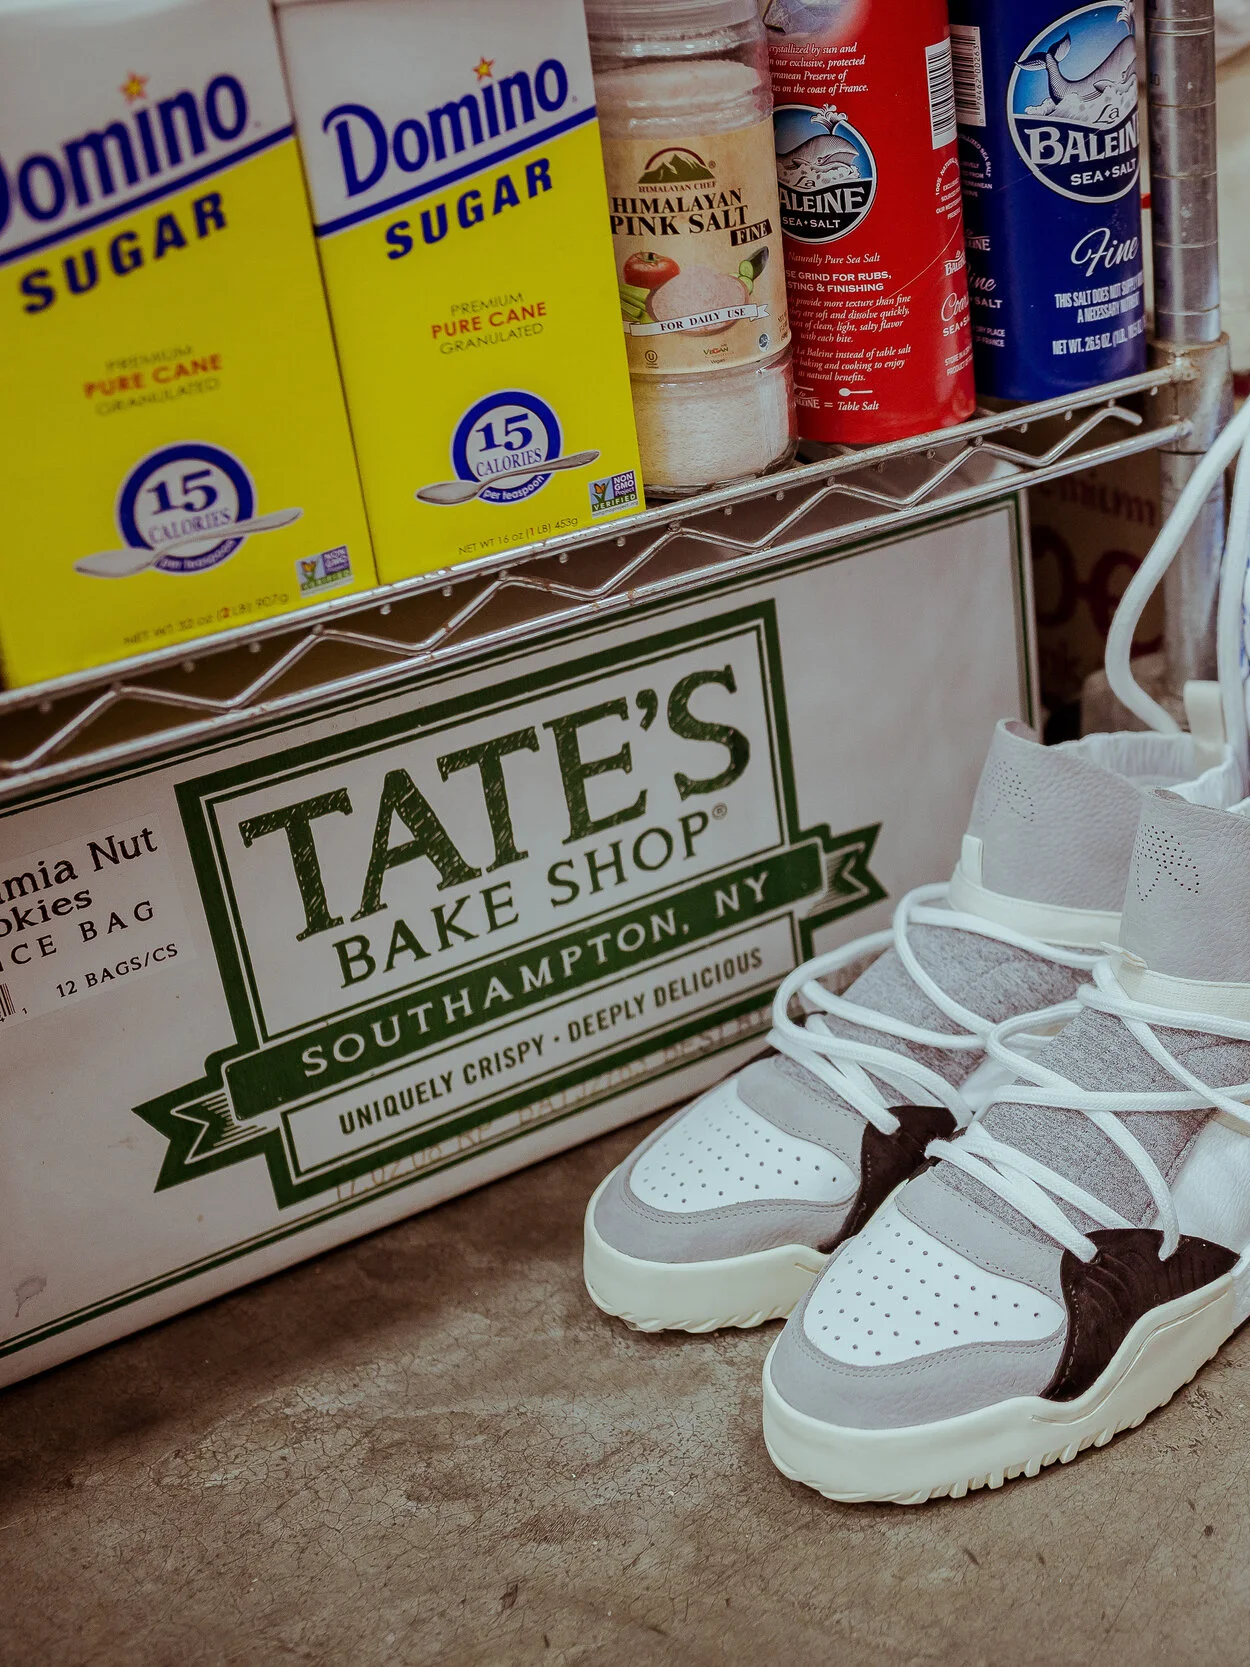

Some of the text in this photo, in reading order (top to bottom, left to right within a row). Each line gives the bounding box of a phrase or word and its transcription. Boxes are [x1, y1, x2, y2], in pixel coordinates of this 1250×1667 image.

[811, 44, 820, 56] by
[839, 42, 857, 53] and
[790, 55, 866, 70] exclusive, protected
[804, 70, 848, 82] Preserve of
[794, 83, 805, 93] the
[828, 83, 838, 96] of
[839, 84, 869, 93] France.
[1092, 104, 1120, 125] La
[322, 58, 569, 198] Domino
[0, 73, 248, 238] omino
[793, 176, 816, 189] La
[1070, 157, 1137, 186] SEA SALT
[638, 183, 692, 194] HIMALAYAN
[385, 157, 553, 261] SUGAR
[611, 187, 743, 215] HIMALAYAN
[610, 204, 749, 237] PINK SALT
[782, 217, 840, 228] SEA SALT
[733, 221, 769, 245] FINE
[19, 191, 227, 314] SUGAR
[825, 255, 844, 264] Pure
[846, 255, 861, 264] Sea
[863, 252, 880, 264] Salt
[1070, 228, 1138, 277] Fine
[798, 272, 830, 281] GRIND
[858, 271, 892, 280] RUBS,
[816, 283, 884, 292] & FINISHING
[450, 291, 524, 317] PREMIUM
[845, 299, 874, 307] texture
[876, 296, 895, 306] than
[895, 294, 911, 307] fine
[1054, 290, 1091, 308] THIS SALT
[431, 301, 547, 340] PURE CANE
[660, 307, 747, 332] FOR DAILY USE
[830, 311, 846, 319] and
[848, 309, 877, 320] dissolve
[880, 305, 910, 321] quickly,
[1077, 309, 1084, 324] A
[836, 319, 904, 333] light, salty flavor
[439, 322, 544, 356] GRANULATED
[836, 335, 854, 343] bite.
[1052, 340, 1067, 355] NET
[1068, 339, 1085, 354] WT.
[835, 349, 864, 359] instead
[866, 348, 876, 360] of
[876, 346, 896, 357] table
[897, 344, 911, 354] salt
[84, 353, 223, 399] PURE CANE
[824, 361, 840, 370] and
[841, 360, 873, 372] cooking
[884, 358, 906, 370] enjoy
[834, 372, 866, 384] benefits.
[837, 400, 880, 411] Table Salt
[475, 412, 533, 453] 15
[476, 447, 543, 478] CALORIES
[501, 474, 545, 501] teaspoon
[613, 472, 634, 484] NON
[614, 479, 635, 492] GMO
[146, 468, 218, 516] 15
[592, 492, 638, 512] VERIFIED
[615, 485, 636, 497] Project
[148, 508, 234, 546] CALORIES
[457, 516, 579, 556] NET WT 16 oz 453g
[238, 663, 752, 943] TATE'S
[0, 827, 158, 905] mia Nut
[332, 807, 712, 990] BAKE SHOP
[77, 900, 154, 943] BAG
[56, 942, 179, 998] 12 BAGS/CS
[300, 907, 691, 1079] SOUTHAMPTON,
[714, 867, 773, 919] NY
[337, 1067, 457, 1138] UNIQUELY
[462, 1032, 546, 1086] CRISPY
[566, 990, 647, 1047] DEEPLY
[653, 946, 764, 1010] DELICIOUS
